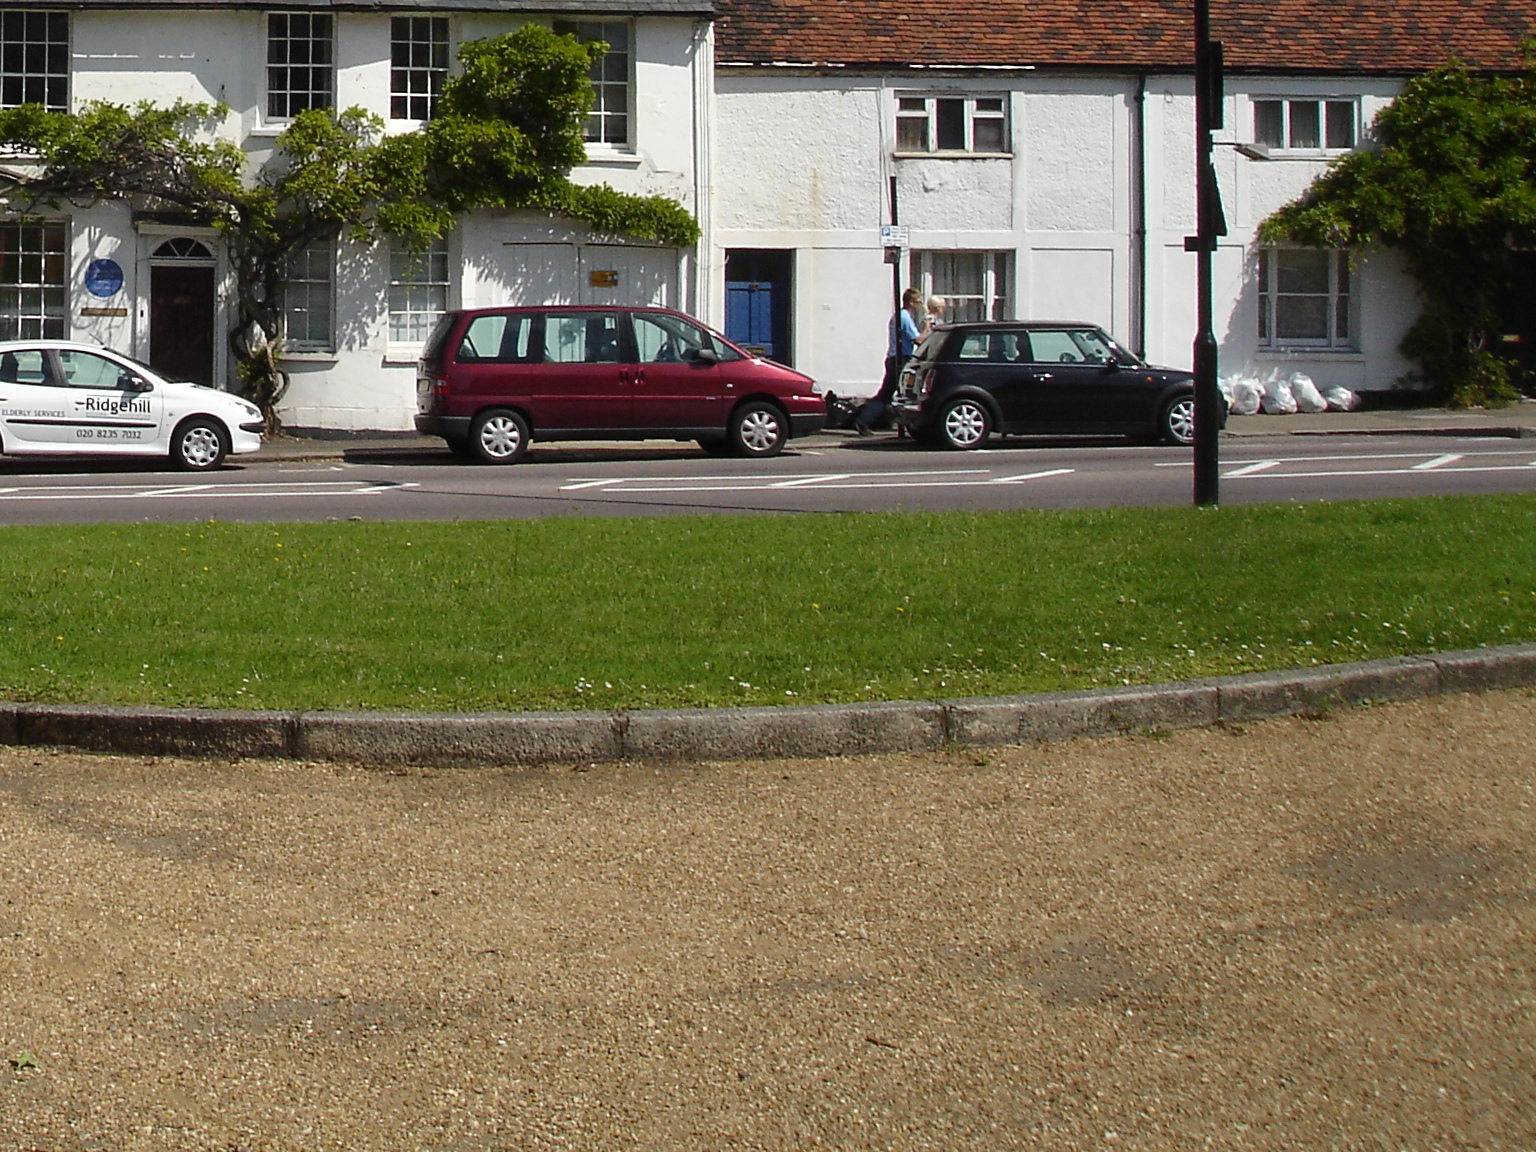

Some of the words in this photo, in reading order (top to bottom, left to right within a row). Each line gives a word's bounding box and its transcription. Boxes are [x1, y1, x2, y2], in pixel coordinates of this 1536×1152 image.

[85, 397, 151, 415] Ridgehill
[1, 409, 31, 417] ELDERLY
[33, 410, 66, 418] SERVICES
[76, 429, 94, 438] 020
[96, 429, 118, 439] 8235
